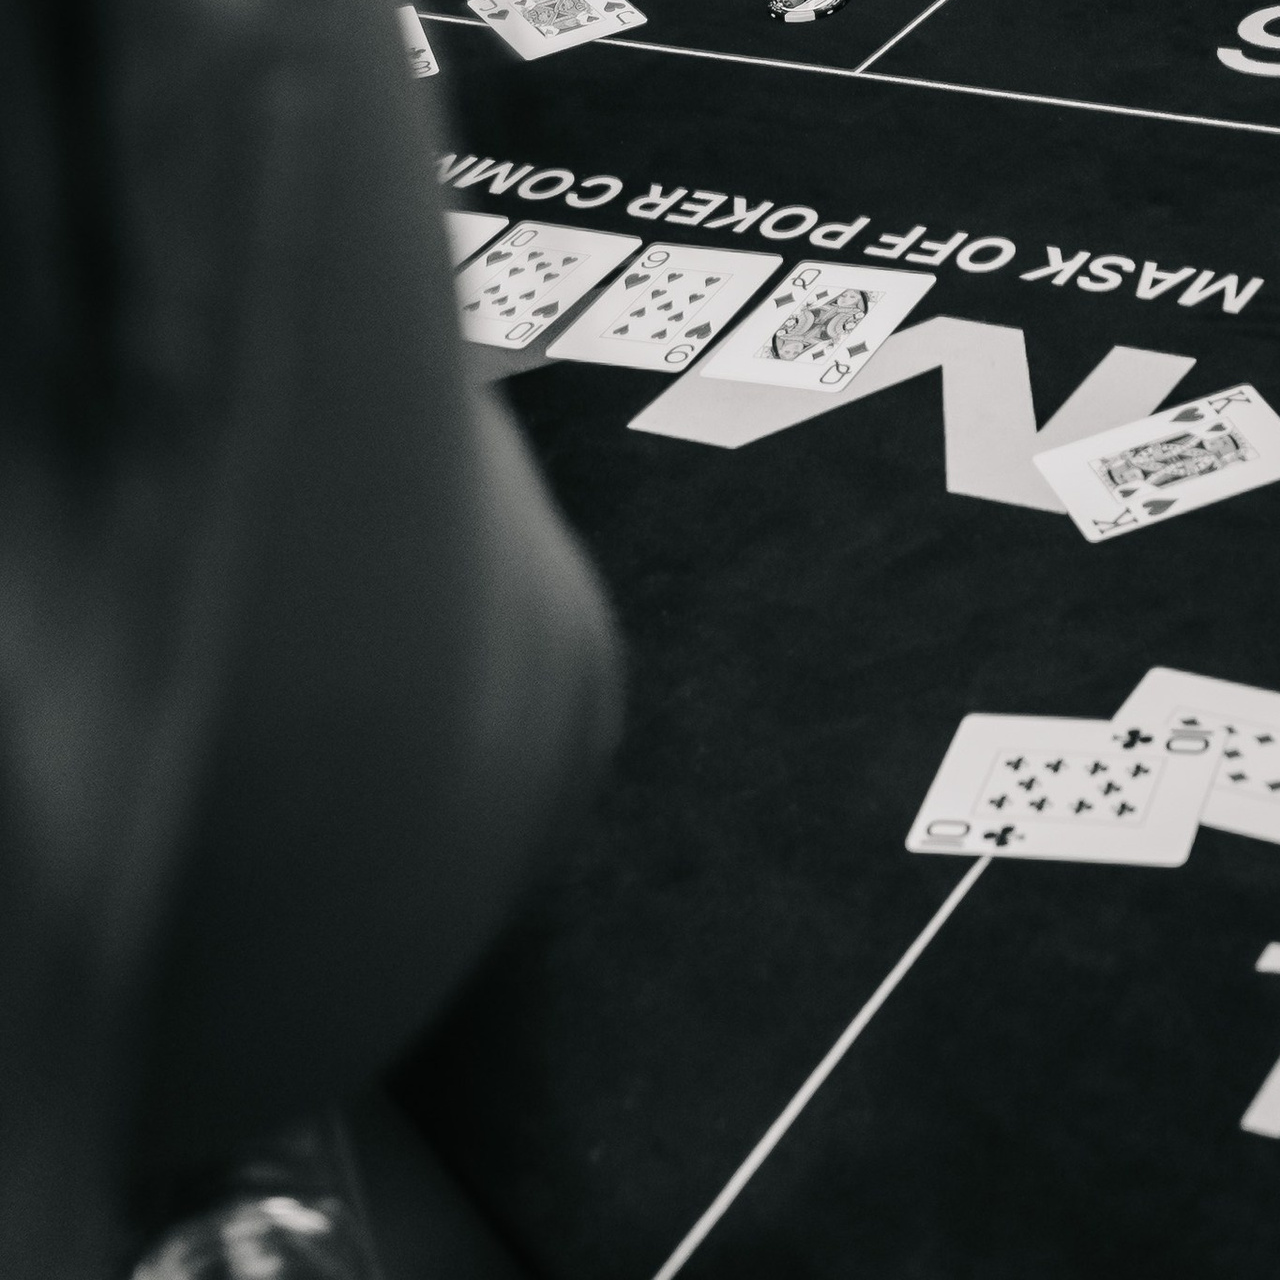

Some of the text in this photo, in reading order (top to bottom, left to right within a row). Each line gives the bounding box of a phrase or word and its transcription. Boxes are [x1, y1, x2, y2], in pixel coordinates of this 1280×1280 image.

[626, 183, 871, 250] POKER
[501, 228, 539, 248] 10
[863, 224, 1017, 274] OFF
[641, 250, 671, 269] 9
[792, 268, 822, 290] Q
[1020, 244, 1265, 314] MASK
[1207, 390, 1252, 415] K
